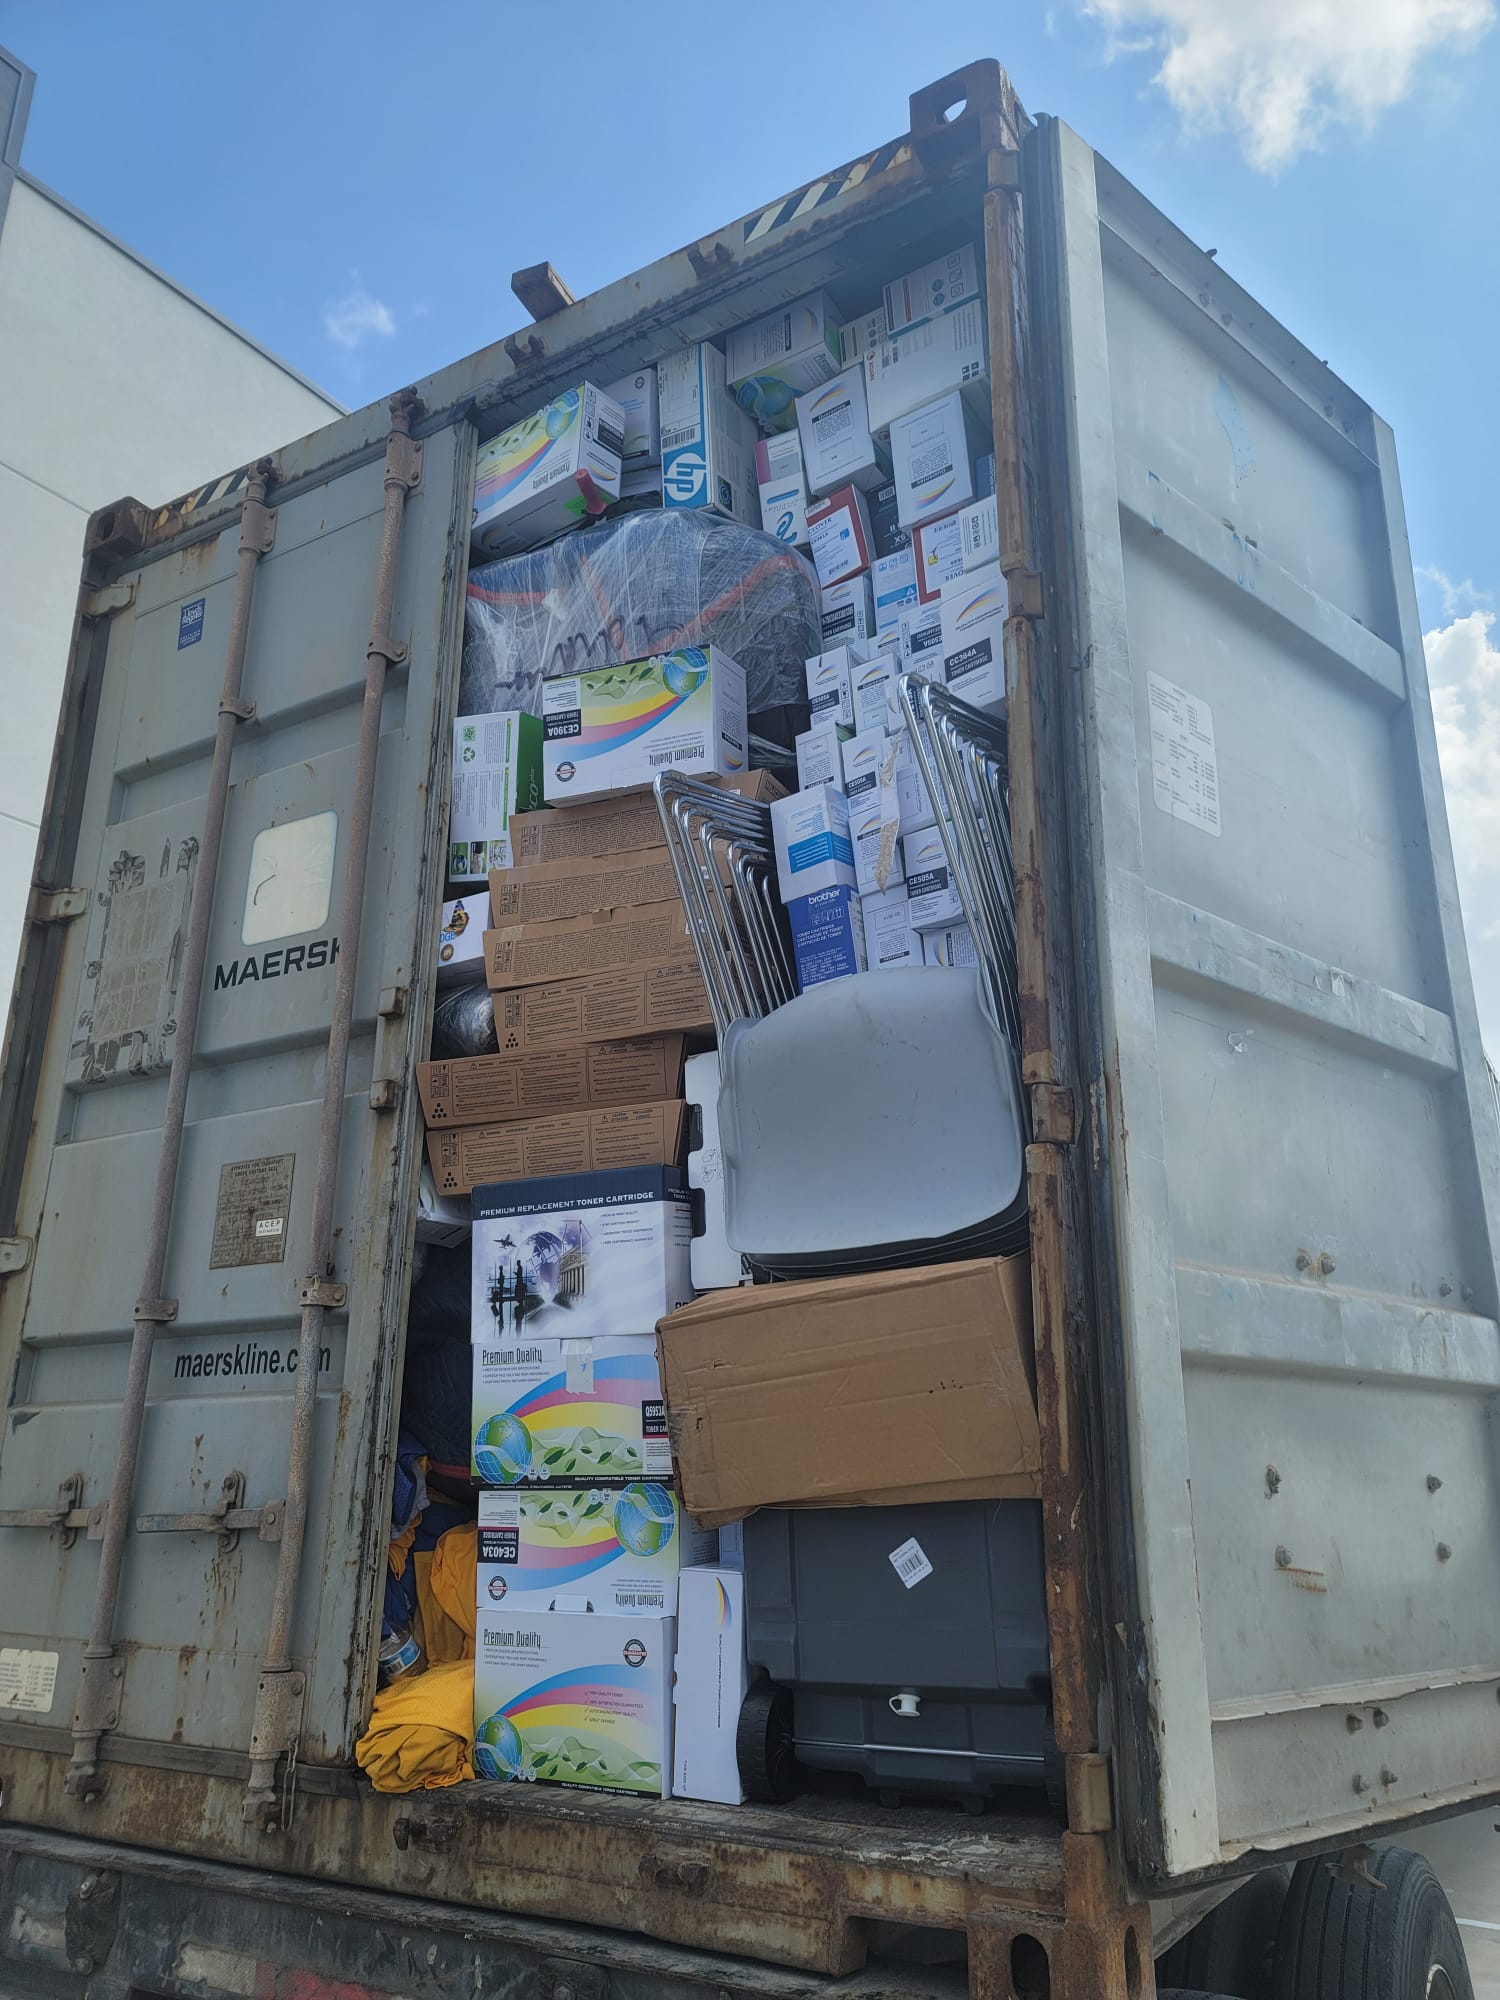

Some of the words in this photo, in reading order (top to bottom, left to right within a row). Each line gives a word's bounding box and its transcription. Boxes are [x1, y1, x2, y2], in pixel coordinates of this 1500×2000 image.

[949, 648, 977, 666] CC364A
[548, 723, 580, 738] CE390A
[649, 749, 676, 767] Quality
[676, 747, 705, 760] Premium
[909, 872, 935, 886] CE505A
[808, 889, 842, 905] brother
[480, 1207, 516, 1217] PREMIUM
[517, 1199, 575, 1213] REPLACEMENT
[576, 1196, 605, 1207] TONER
[605, 1191, 654, 1204] CARTRIDGE
[174, 1343, 331, 1379] maerskline.cm
[482, 1350, 515, 1365] Premium
[516, 1346, 543, 1365] Quality
[482, 1545, 516, 1558] CE403A
[615, 1593, 636, 1607] Quality
[637, 1595, 665, 1608] Premium
[484, 1629, 515, 1646] Premium
[515, 1630, 542, 1649] Quality
